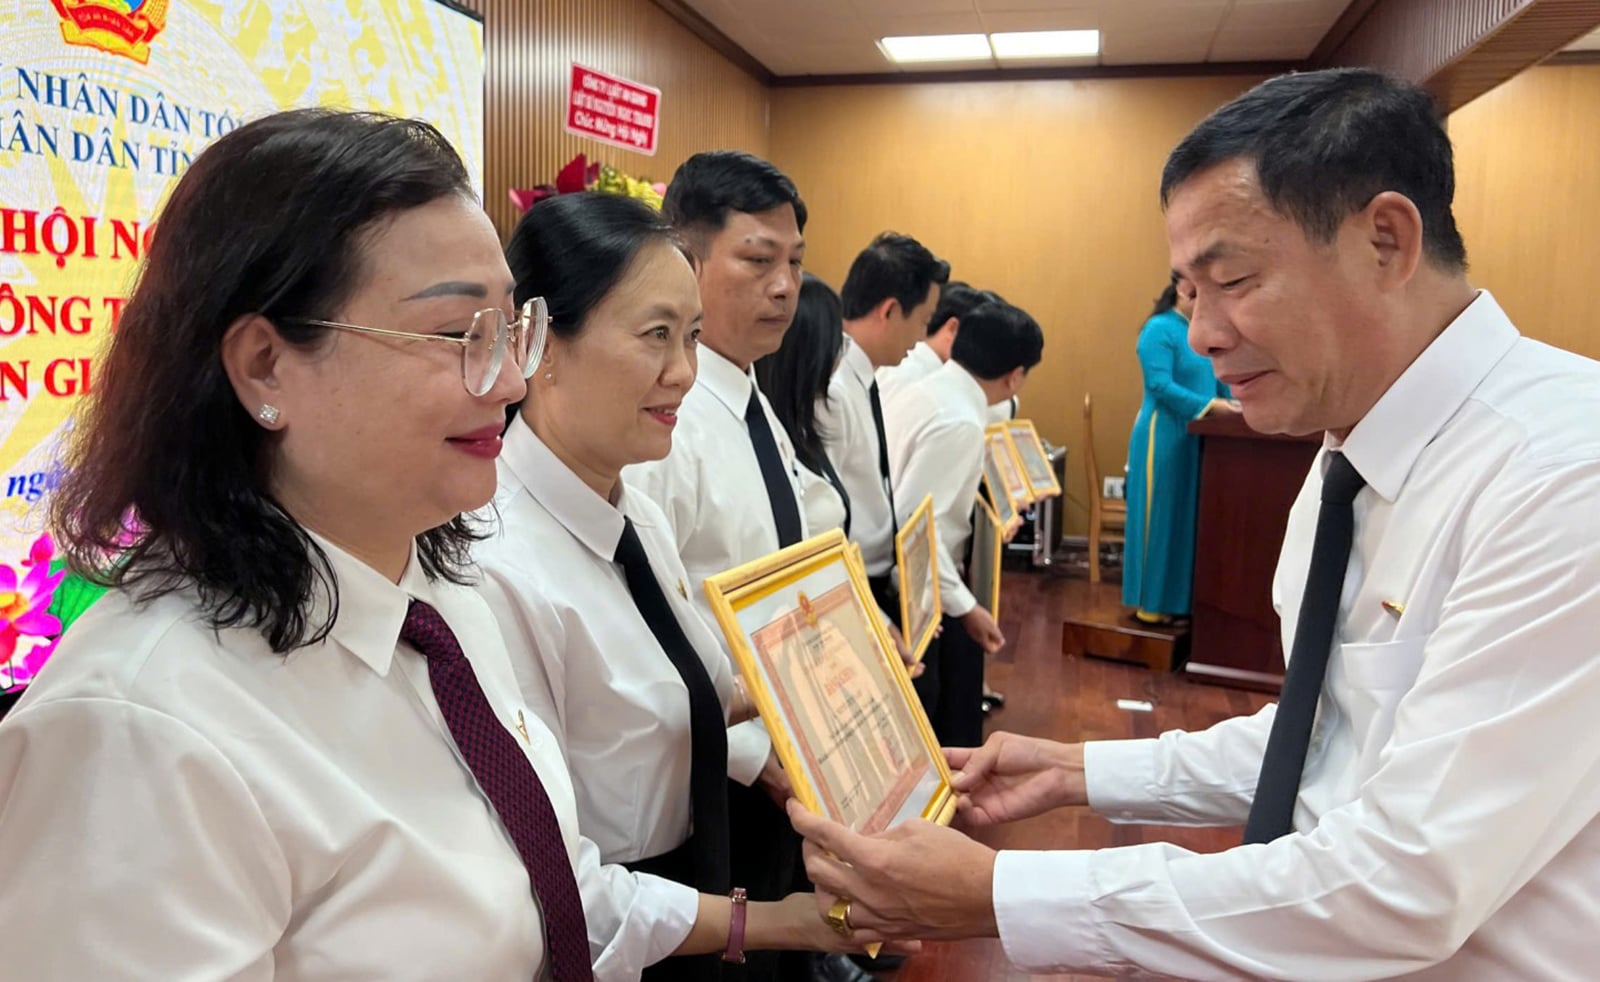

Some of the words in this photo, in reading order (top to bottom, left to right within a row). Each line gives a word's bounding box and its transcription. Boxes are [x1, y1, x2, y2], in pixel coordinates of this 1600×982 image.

[16, 66, 119, 119] NHÂN
[129, 91, 191, 134] DÂN
[72, 127, 141, 171] DÂN
[0, 206, 98, 269] HỘI
